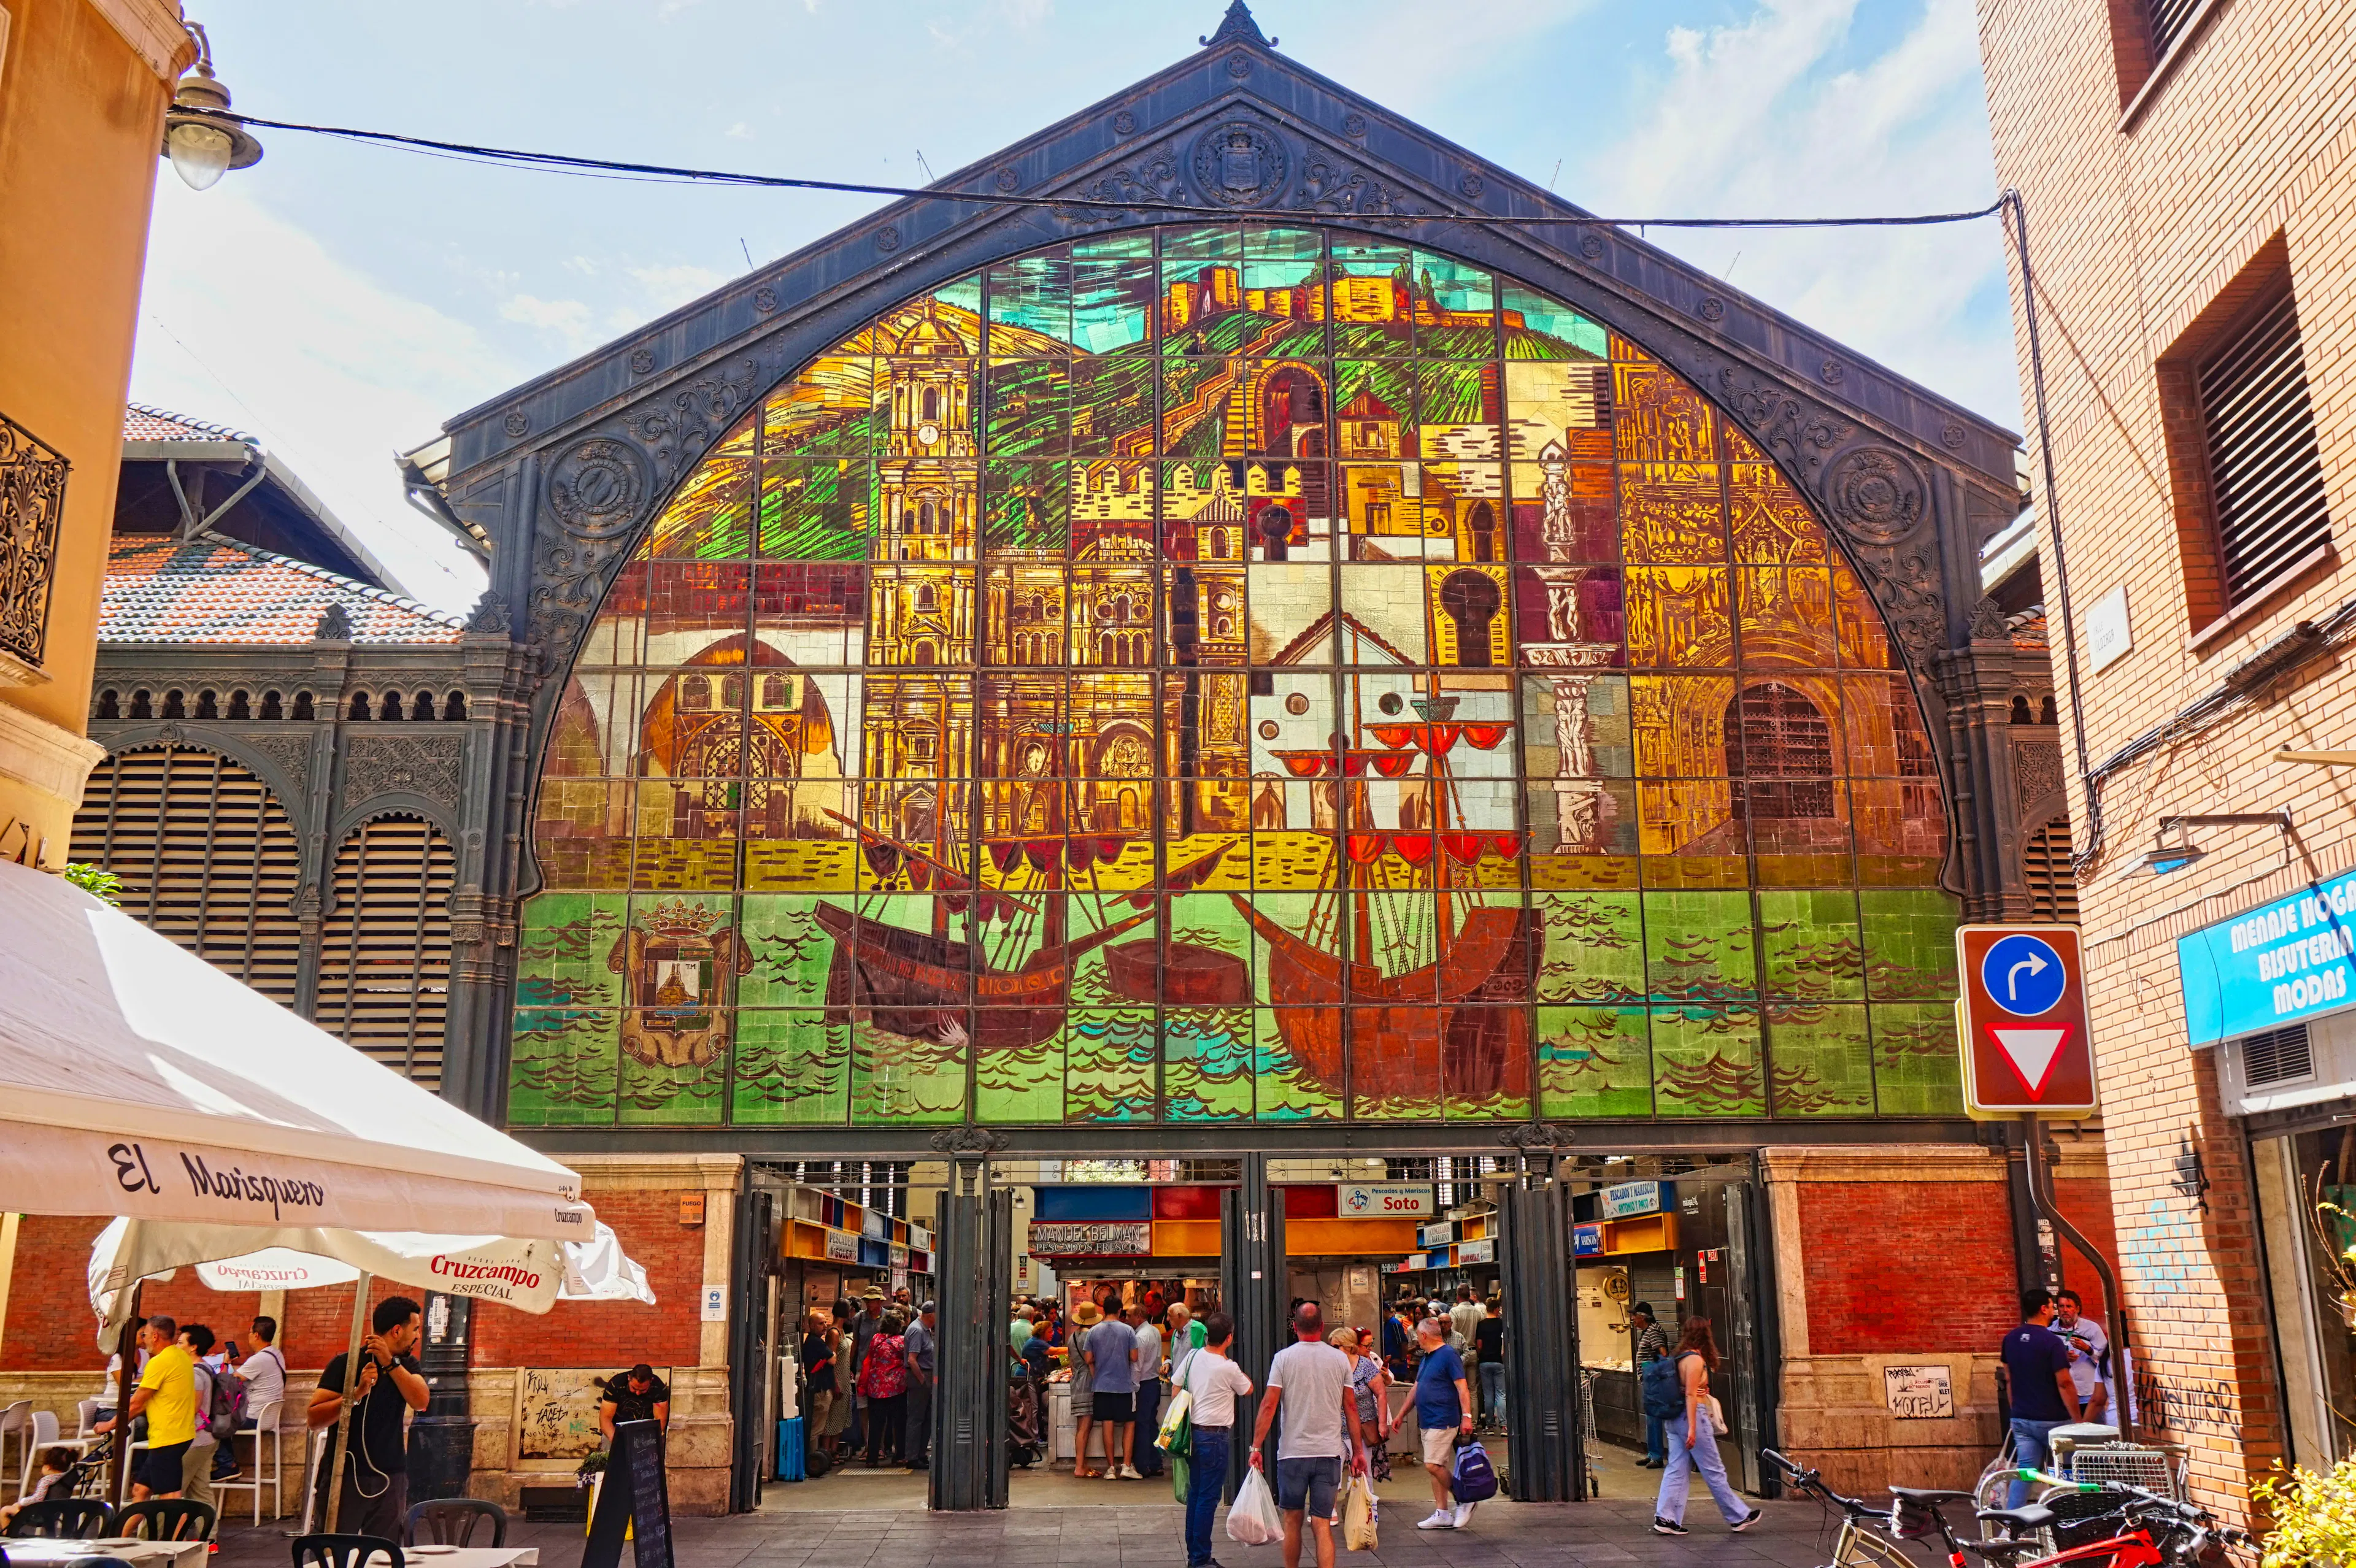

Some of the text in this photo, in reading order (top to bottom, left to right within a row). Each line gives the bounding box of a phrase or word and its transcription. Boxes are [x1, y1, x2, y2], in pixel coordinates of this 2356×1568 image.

[2231, 904, 2298, 953] MENAJE
[2258, 924, 2354, 982] BISUTERIA
[2273, 966, 2346, 1014] MODAS
[107, 1143, 323, 1221] El Marisquero
[1610, 1182, 1655, 1201] PESCADOS Y MARISCOS
[1384, 1197, 1419, 1210] Soto
[1619, 1202, 1634, 1214] ANTONIO
[1634, 1200, 1639, 1212] Y
[555, 1208, 582, 1226] Cruzcampo
[1037, 1226, 1141, 1241] MANUEL BELMAN
[1036, 1242, 1144, 1252] PESCADOS FRESCOS
[431, 1254, 540, 1288] Cruzcampo
[450, 1284, 514, 1300] ESPECIAL
